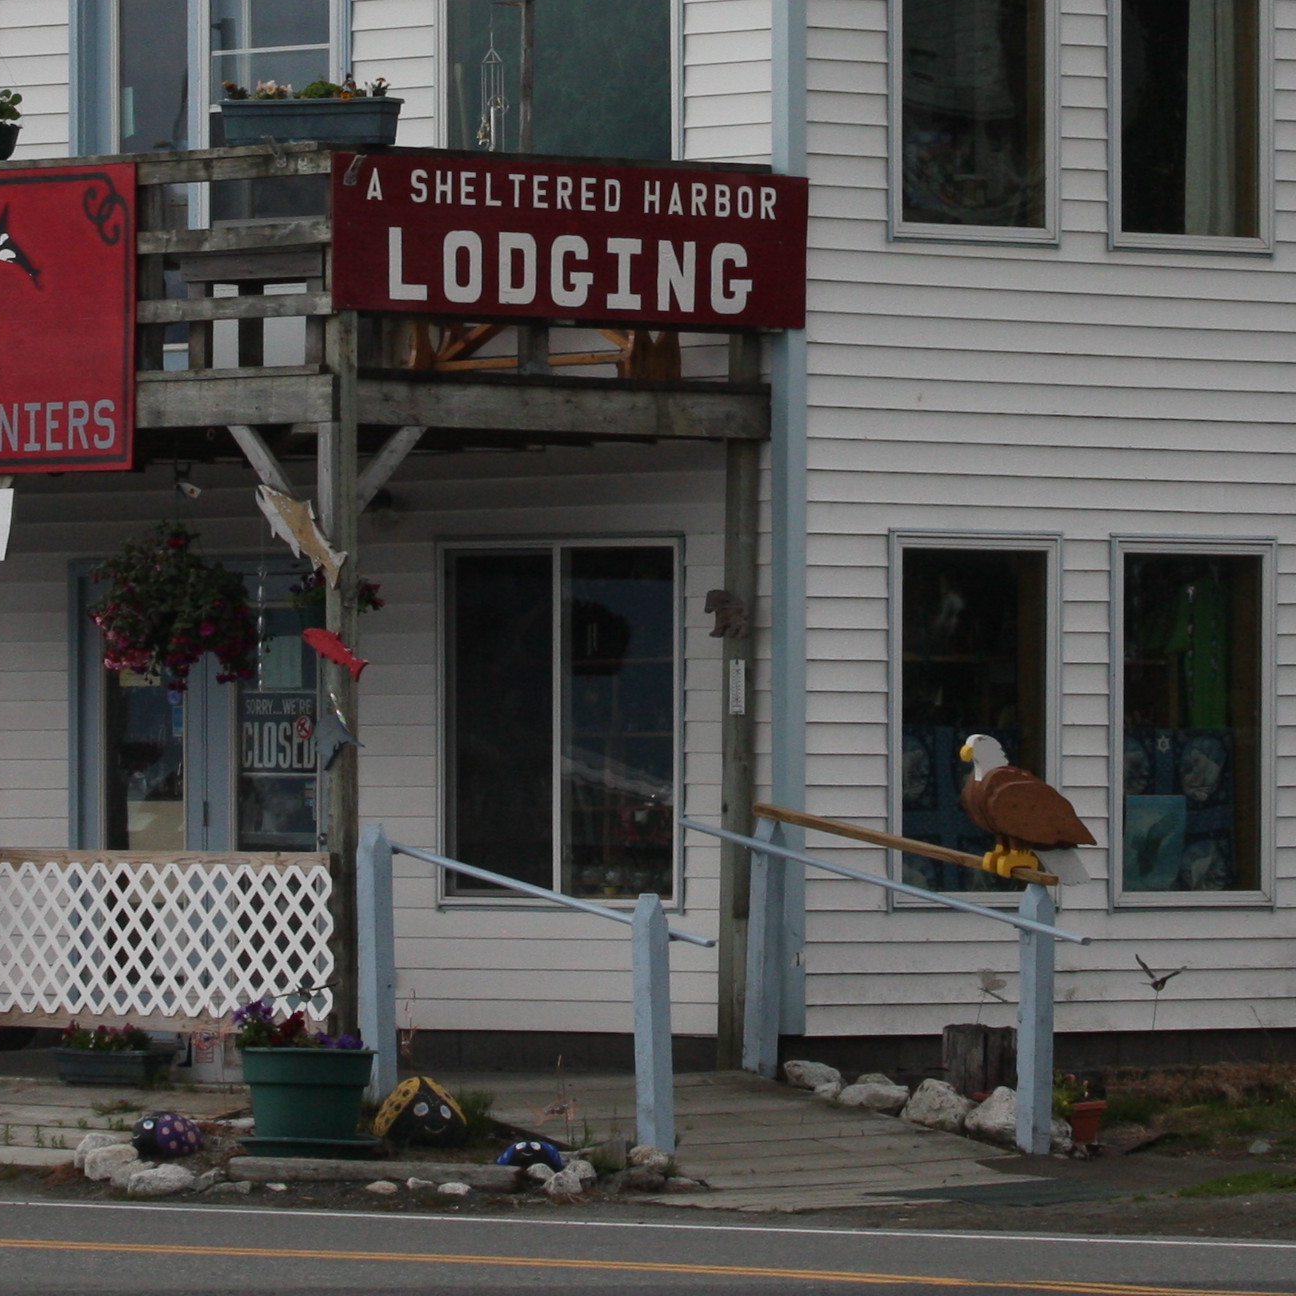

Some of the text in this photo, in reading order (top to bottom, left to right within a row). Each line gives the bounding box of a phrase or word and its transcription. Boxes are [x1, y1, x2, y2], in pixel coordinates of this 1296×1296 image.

[366, 167, 777, 220] A SHELTERED HARBOR
[388, 226, 753, 315] LODGING
[241, 721, 316, 770] CLOSED
